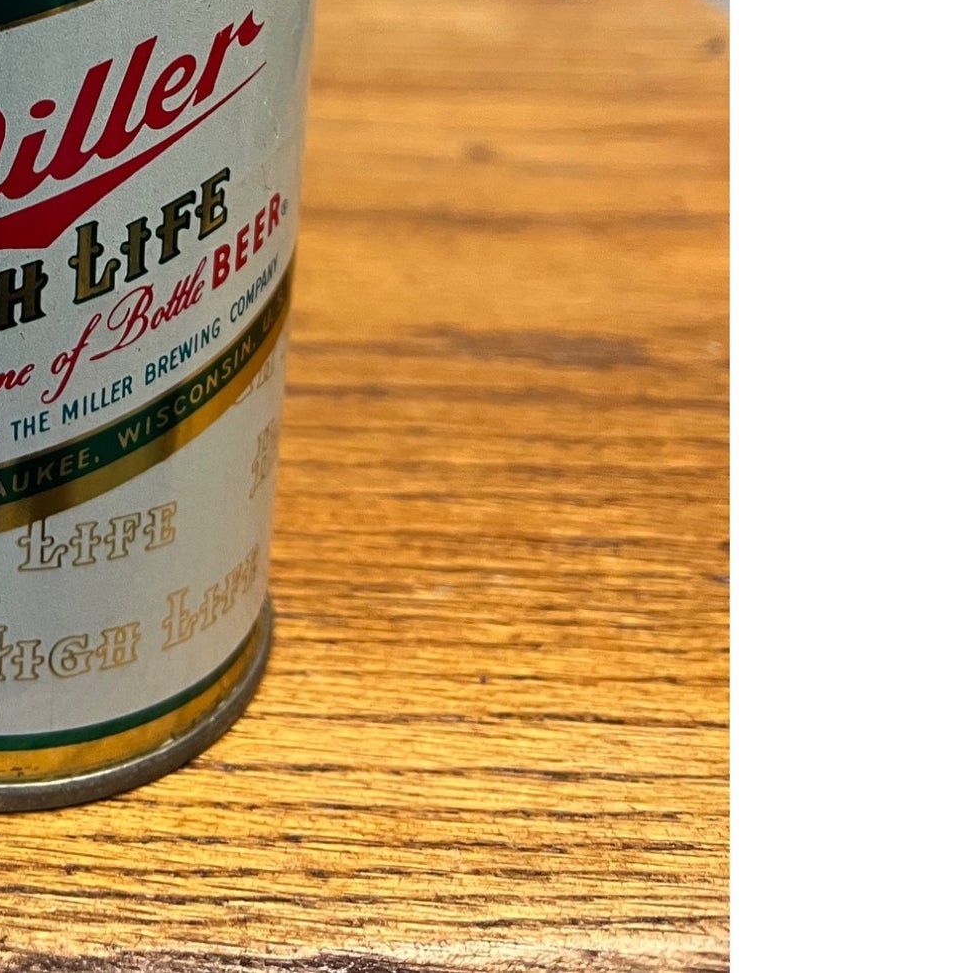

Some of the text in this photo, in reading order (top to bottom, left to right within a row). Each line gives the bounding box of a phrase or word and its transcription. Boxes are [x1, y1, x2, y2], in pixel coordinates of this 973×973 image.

[68, 166, 231, 305] LIFE
[10, 410, 50, 442] THE
[61, 376, 133, 424] MILLER
[144, 317, 221, 386] BREWING
[229, 252, 279, 324] COMPANY
[40, 313, 102, 404] of
[89, 255, 208, 361] Bottle
[17, 500, 177, 572] LIFE
